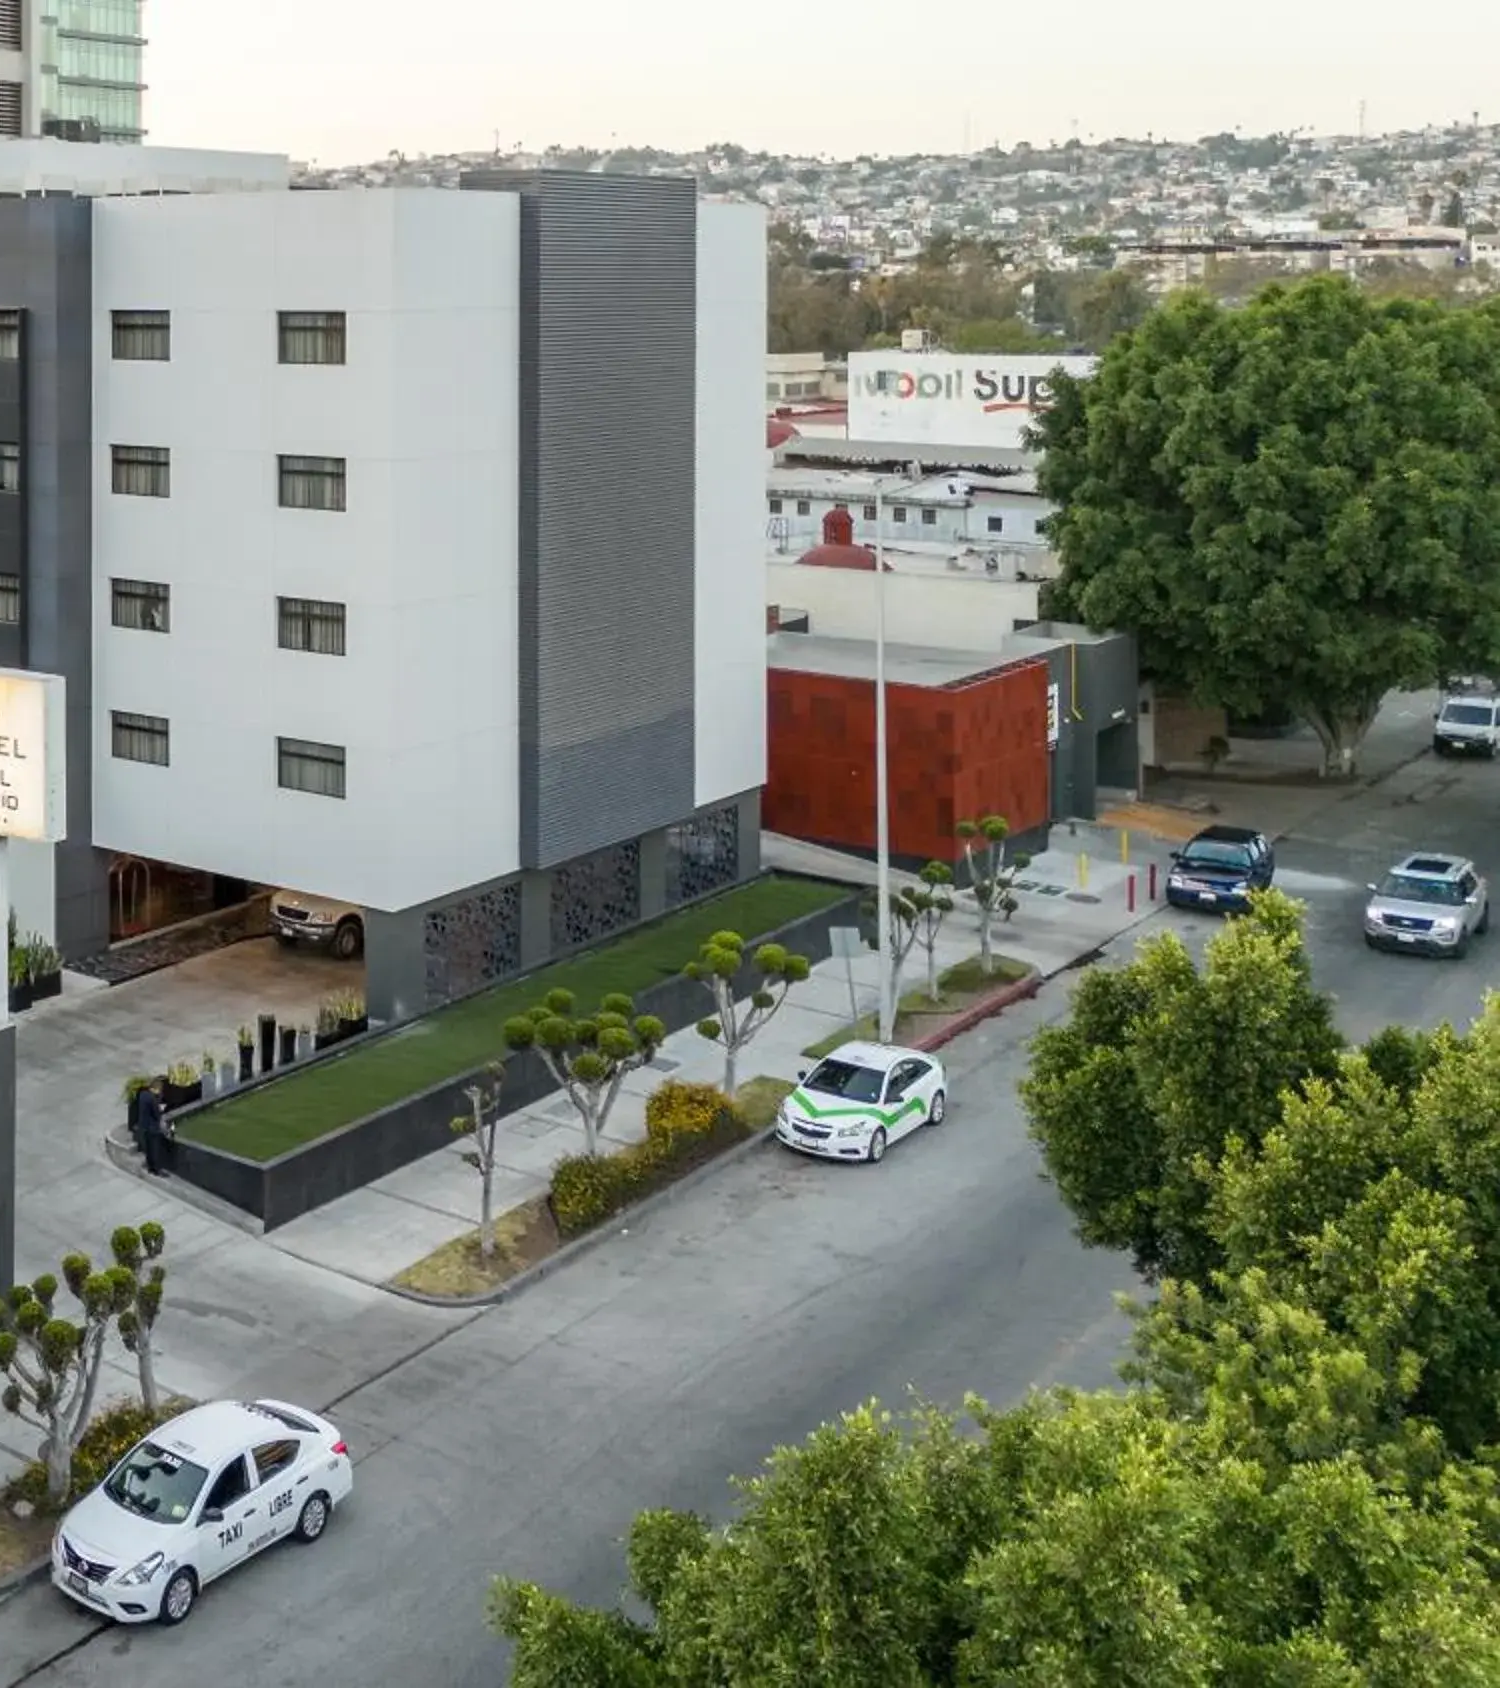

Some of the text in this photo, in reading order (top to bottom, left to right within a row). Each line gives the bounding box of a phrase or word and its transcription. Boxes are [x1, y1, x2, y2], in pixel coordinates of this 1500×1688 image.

[973, 368, 1056, 407] Sup
[217, 1520, 243, 1550] TAXI
[269, 1489, 293, 1518] LIBRE
